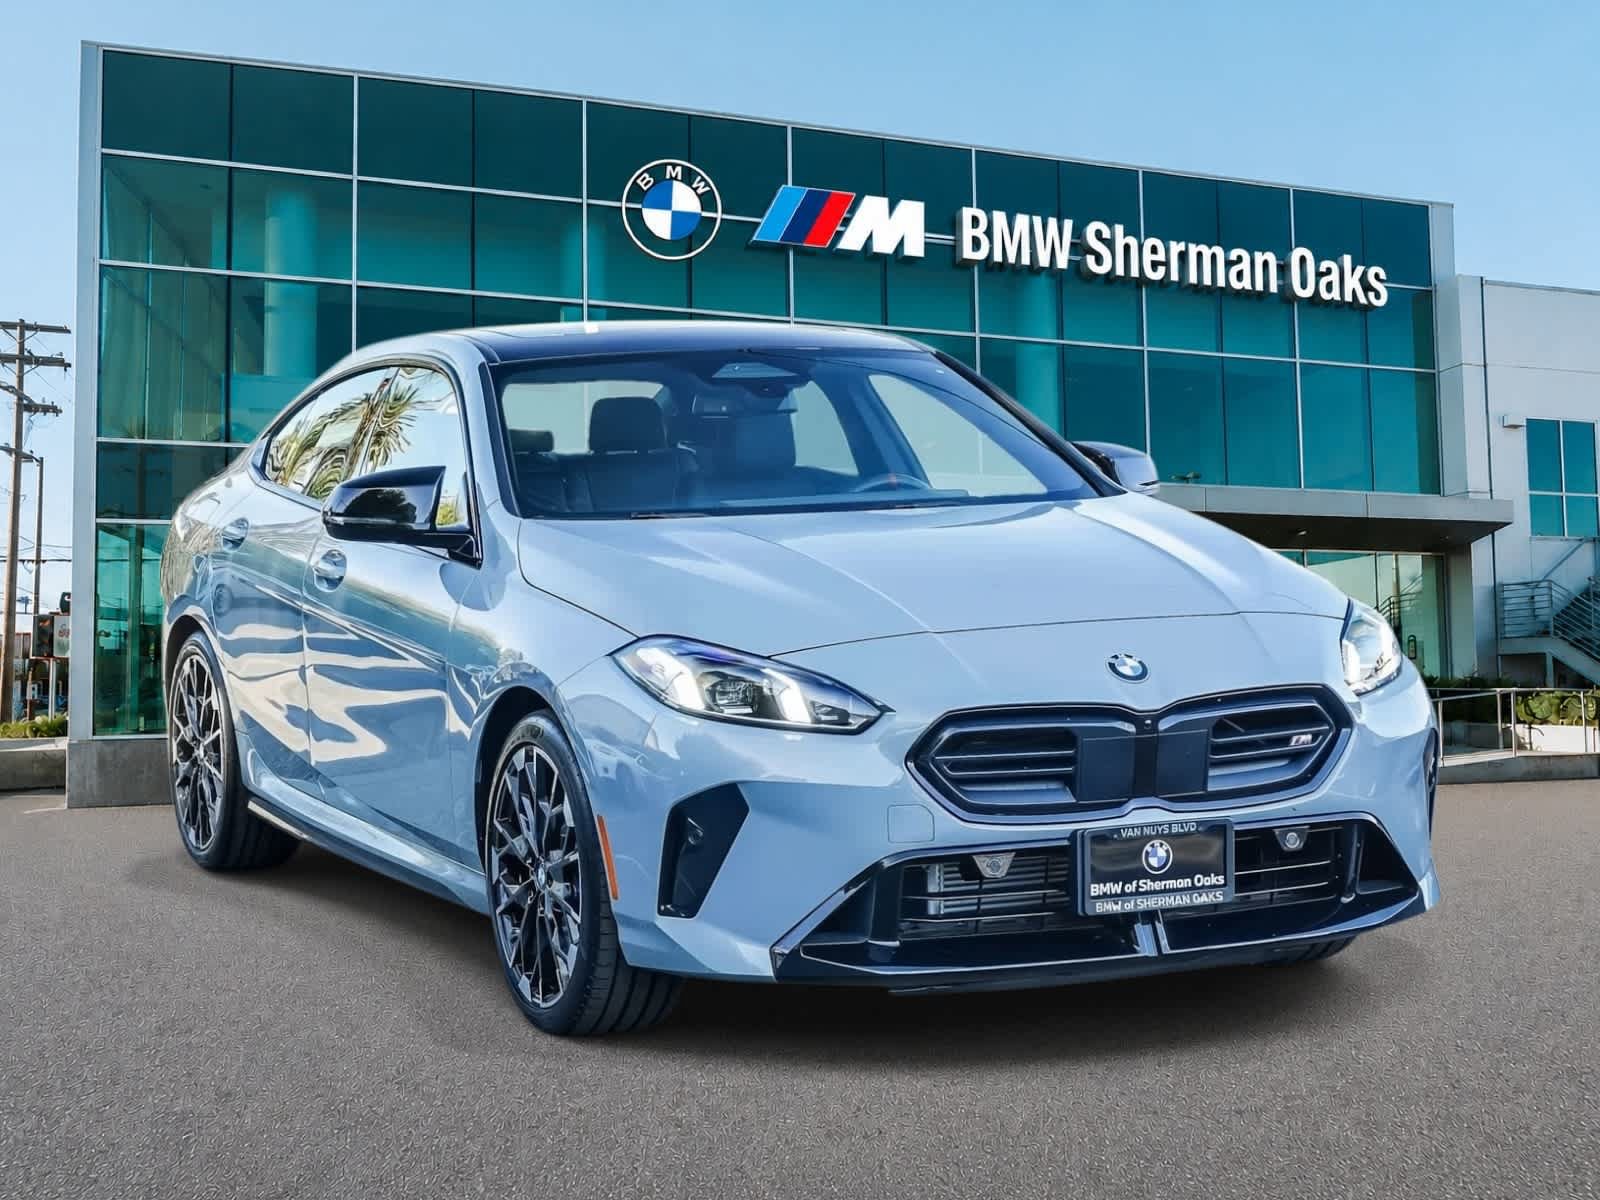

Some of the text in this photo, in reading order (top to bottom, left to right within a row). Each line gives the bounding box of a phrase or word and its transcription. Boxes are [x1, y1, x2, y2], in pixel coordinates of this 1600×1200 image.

[637, 165, 711, 196] BMW
[836, 195, 925, 258] M
[960, 206, 1389, 308] BMW Sherman Oaks
[1120, 822, 1197, 838] VAN NUYS BLVD
[1090, 873, 1225, 897] BMW of Sherman Oaks
[1095, 890, 1224, 913] BMW of SHERMAN OAKS
